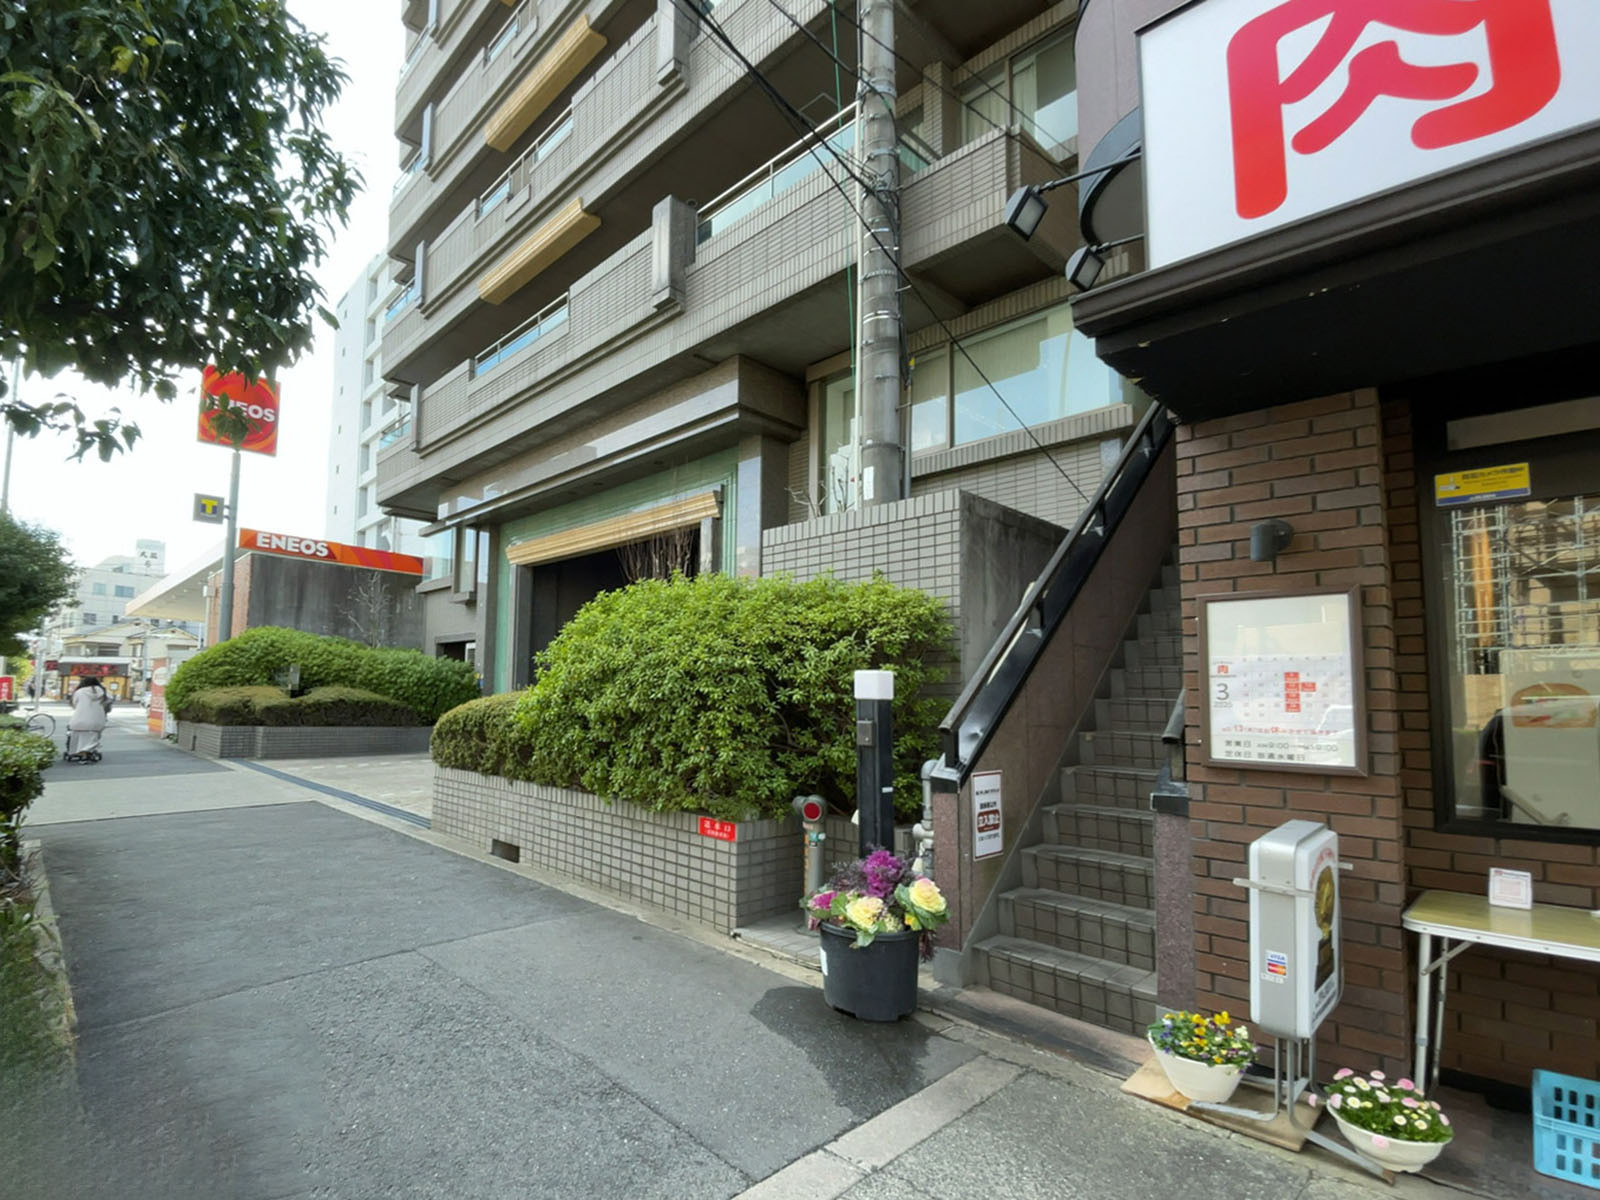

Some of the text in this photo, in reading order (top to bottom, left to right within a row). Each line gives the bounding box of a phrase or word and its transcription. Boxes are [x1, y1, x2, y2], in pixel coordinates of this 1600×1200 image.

[1226, 0, 1562, 220] 肉
[256, 532, 329, 557] ENEOS
[1216, 682, 1230, 701] 3
